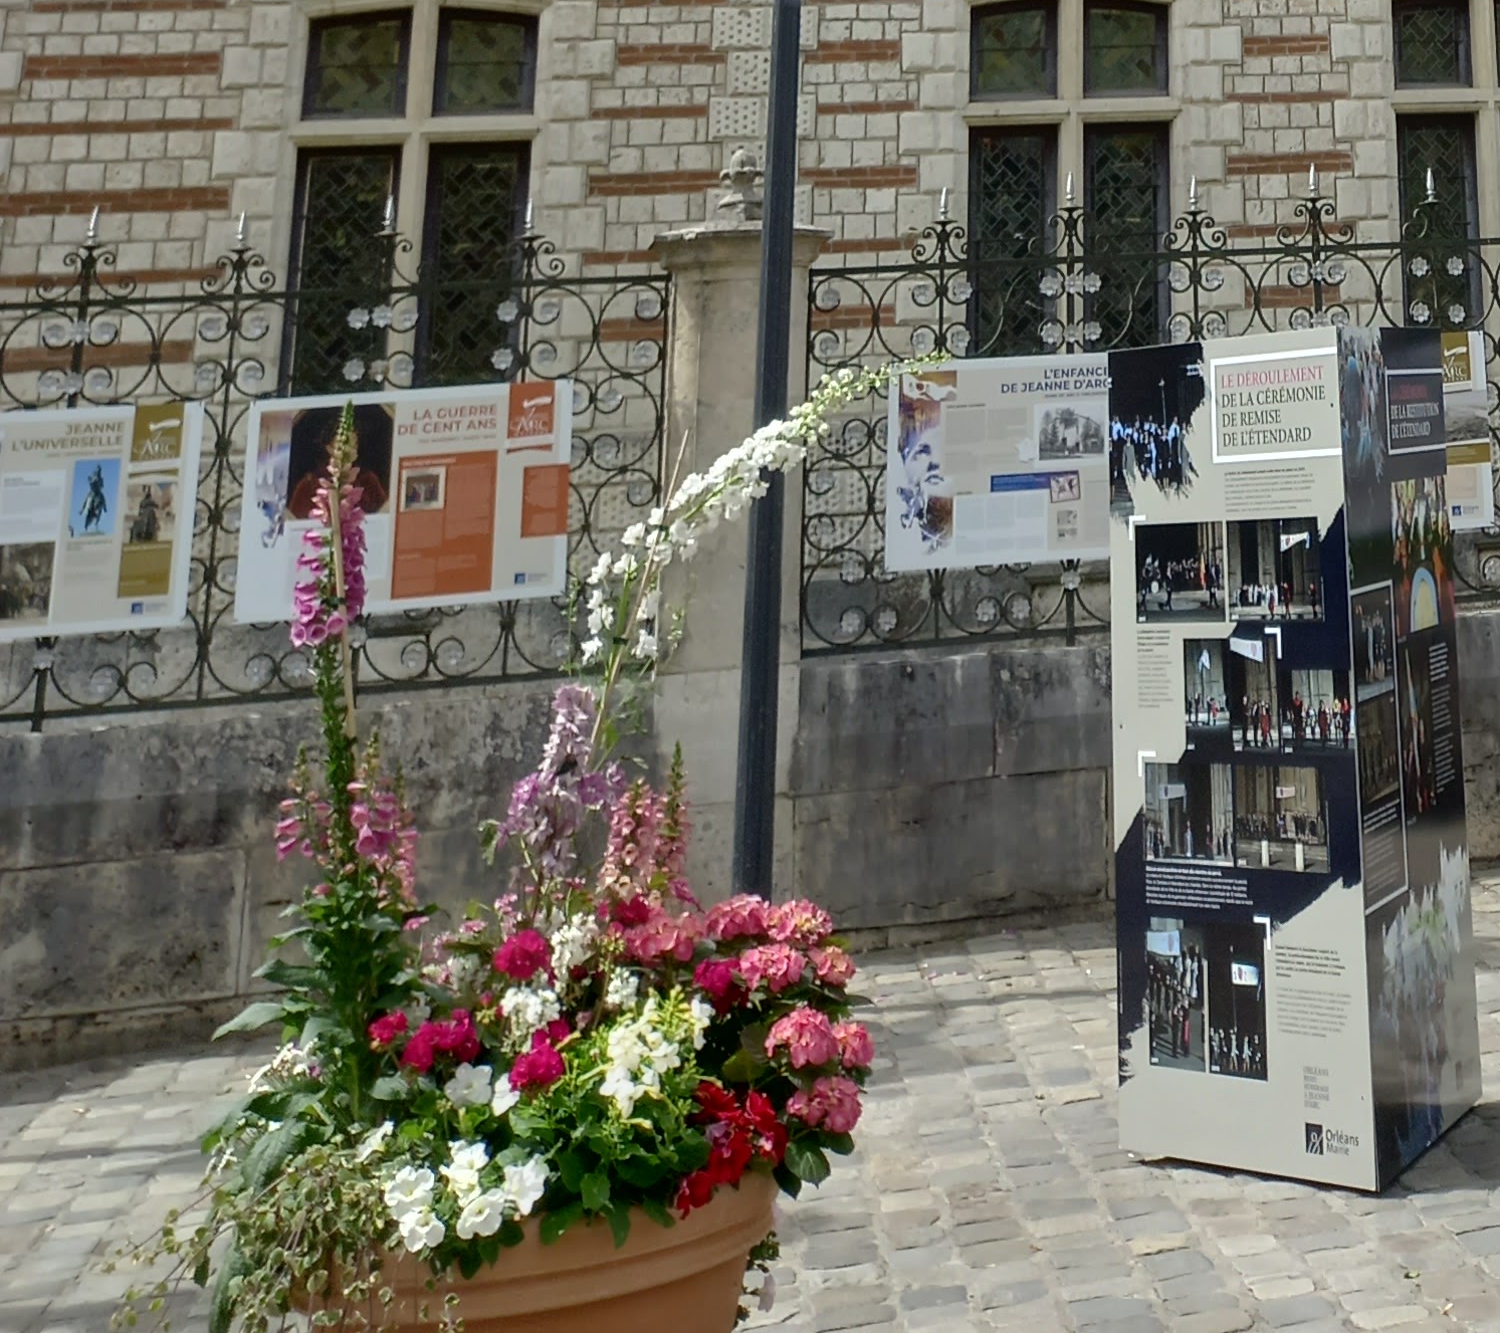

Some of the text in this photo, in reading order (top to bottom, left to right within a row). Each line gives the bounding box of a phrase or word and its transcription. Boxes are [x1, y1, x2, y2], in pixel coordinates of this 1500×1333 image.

[1221, 365, 1324, 389] LE DÉROULEMENT
[1000, 382, 1018, 394] DE
[1020, 380, 1071, 393] JEANNE
[1221, 385, 1326, 408] DE LA CÉRÉMONIE
[413, 405, 496, 420] LA GUERRE
[1222, 409, 1281, 428] DE REMISE
[65, 422, 125, 435] JEANNE
[397, 418, 497, 436] DE CENT ANS
[12, 436, 123, 451] L'UNIVERSELLE
[1222, 426, 1312, 447] DE L'ÉTENDARD
[1325, 1129, 1360, 1147] Orléans
